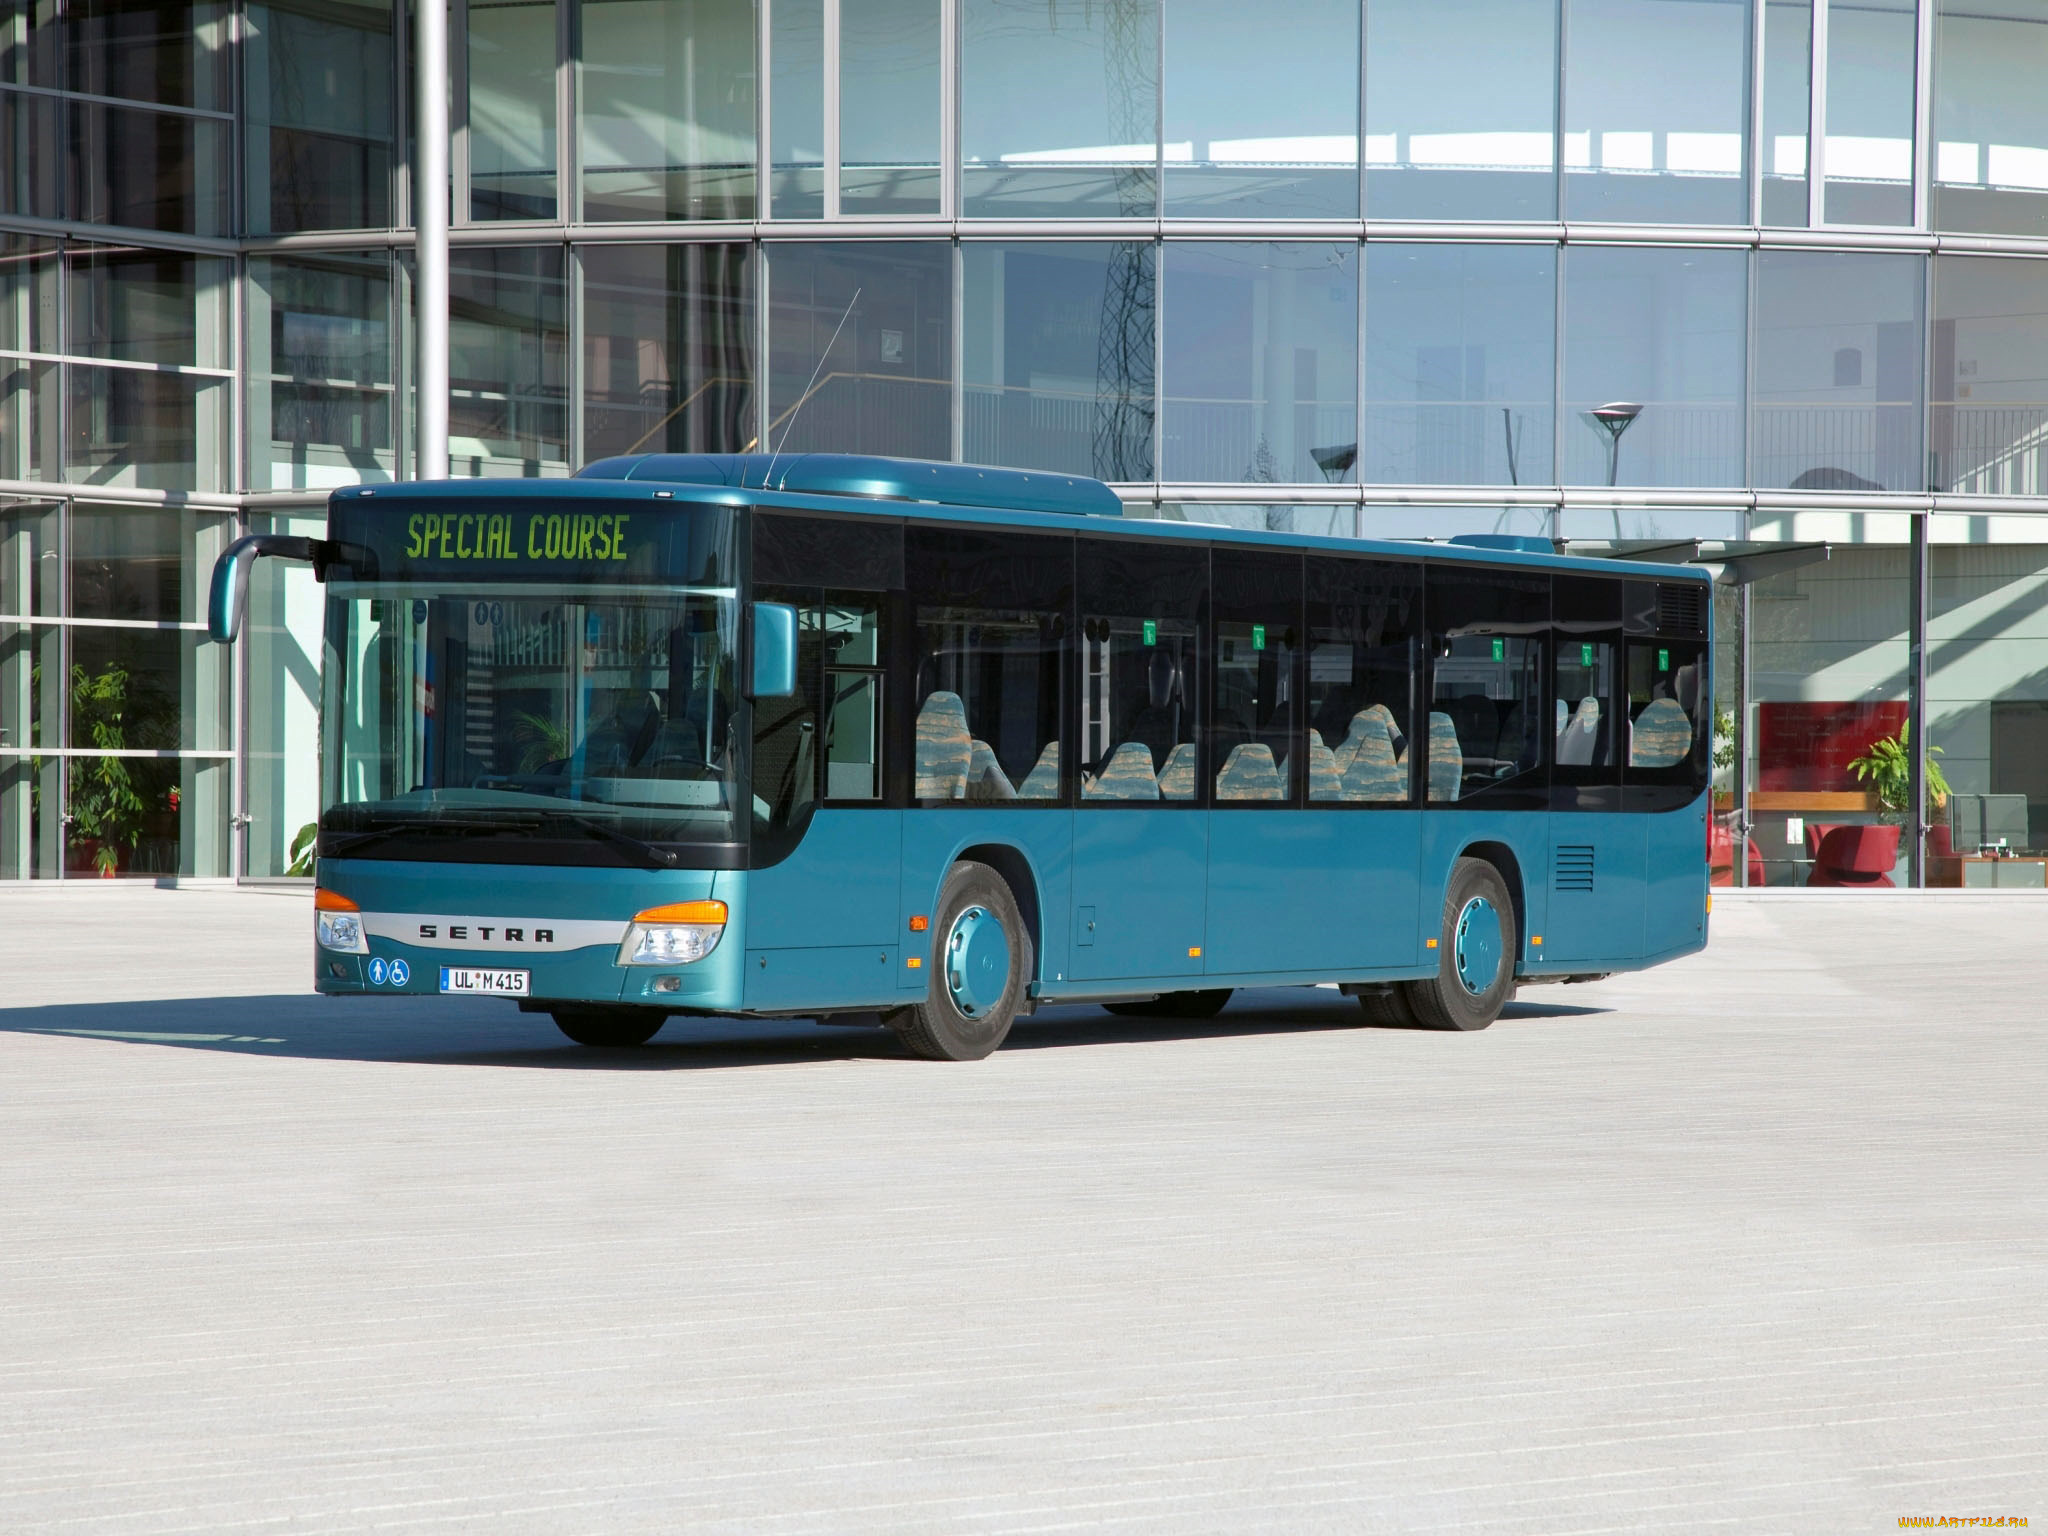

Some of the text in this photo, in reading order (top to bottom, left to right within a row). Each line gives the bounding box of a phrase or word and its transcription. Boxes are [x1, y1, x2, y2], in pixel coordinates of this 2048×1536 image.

[406, 513, 630, 560] SPECIAL COURSE
[419, 925, 554, 943] SETRA
